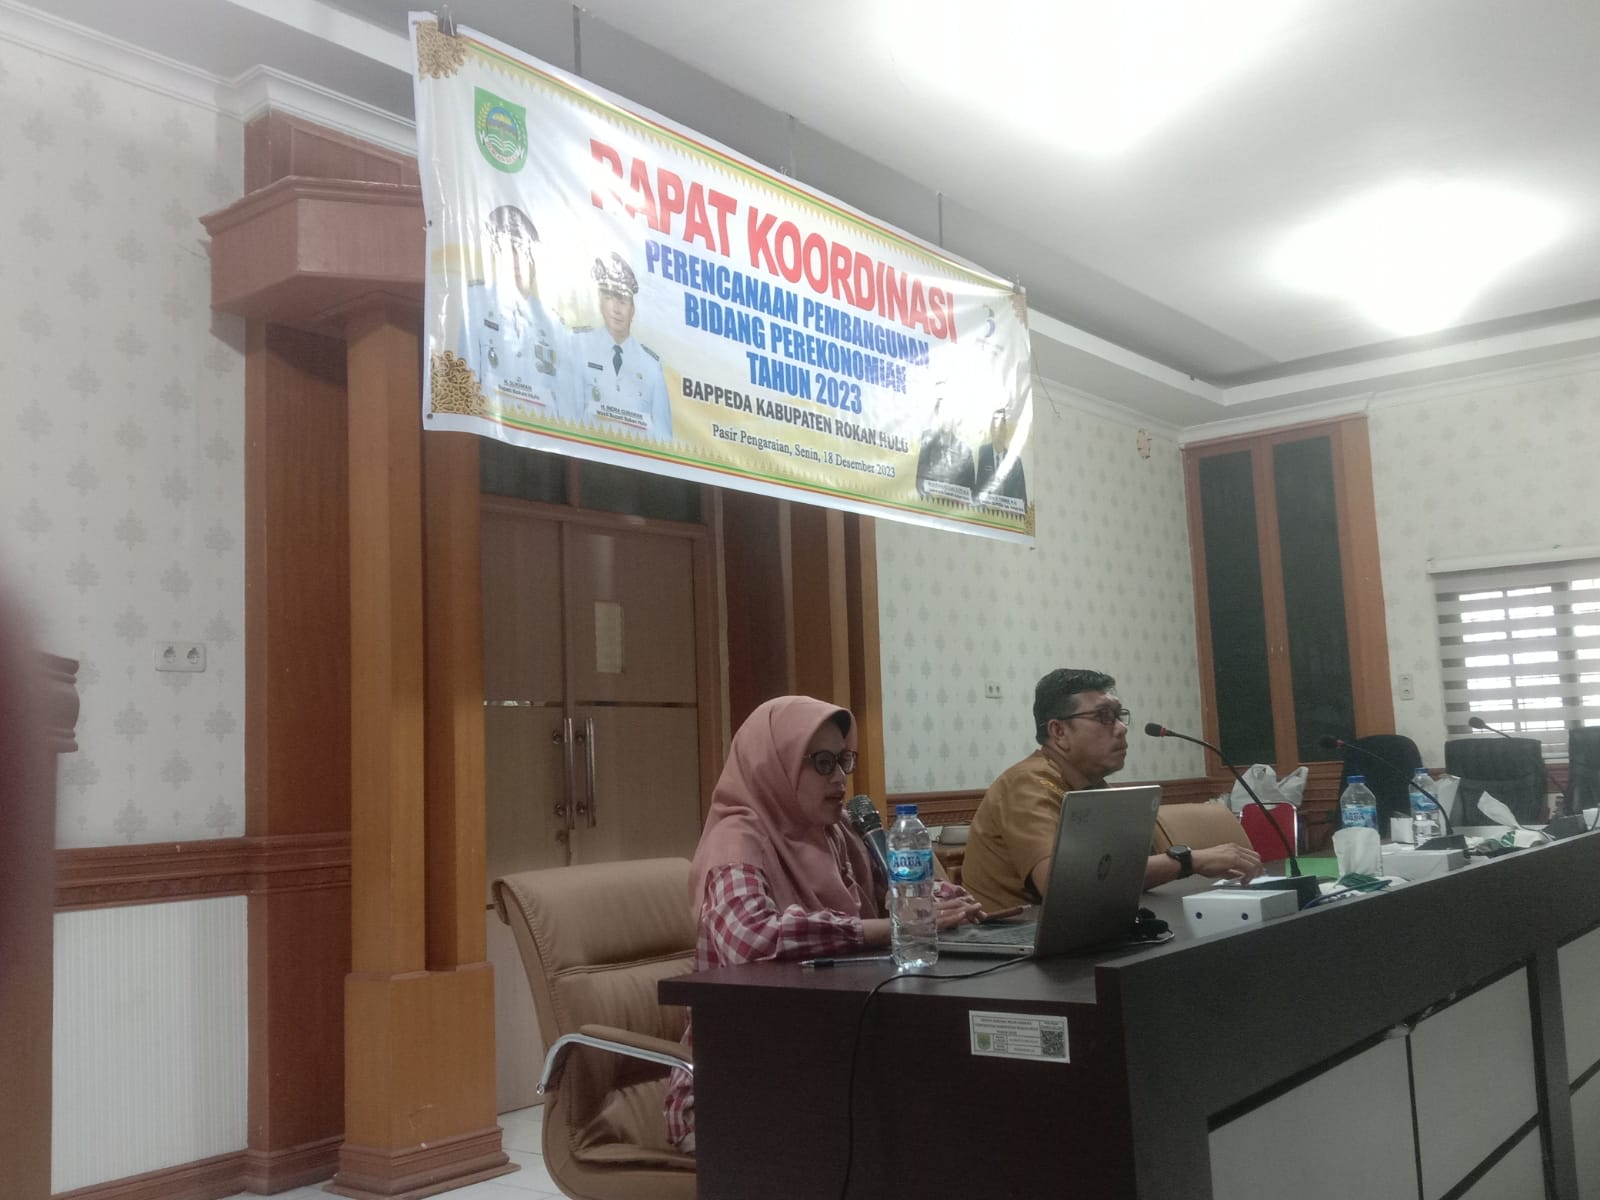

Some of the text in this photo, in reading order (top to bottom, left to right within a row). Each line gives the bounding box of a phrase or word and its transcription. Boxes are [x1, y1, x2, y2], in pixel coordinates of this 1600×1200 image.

[589, 138, 958, 344] RAPAT KOORDINASI
[645, 239, 929, 367] PERENCANAAN PEMBANGUNAN
[684, 291, 907, 394] BIDANG PEREKONOMIAN
[682, 377, 909, 453] BAPPEDA KABUPATEN ROKAN HULU
[746, 351, 862, 415] TAHUN 2023
[712, 424, 896, 478] Pasir Pengaraian, Senin, 18 Desember 2023
[894, 856, 922, 868] AQUA
